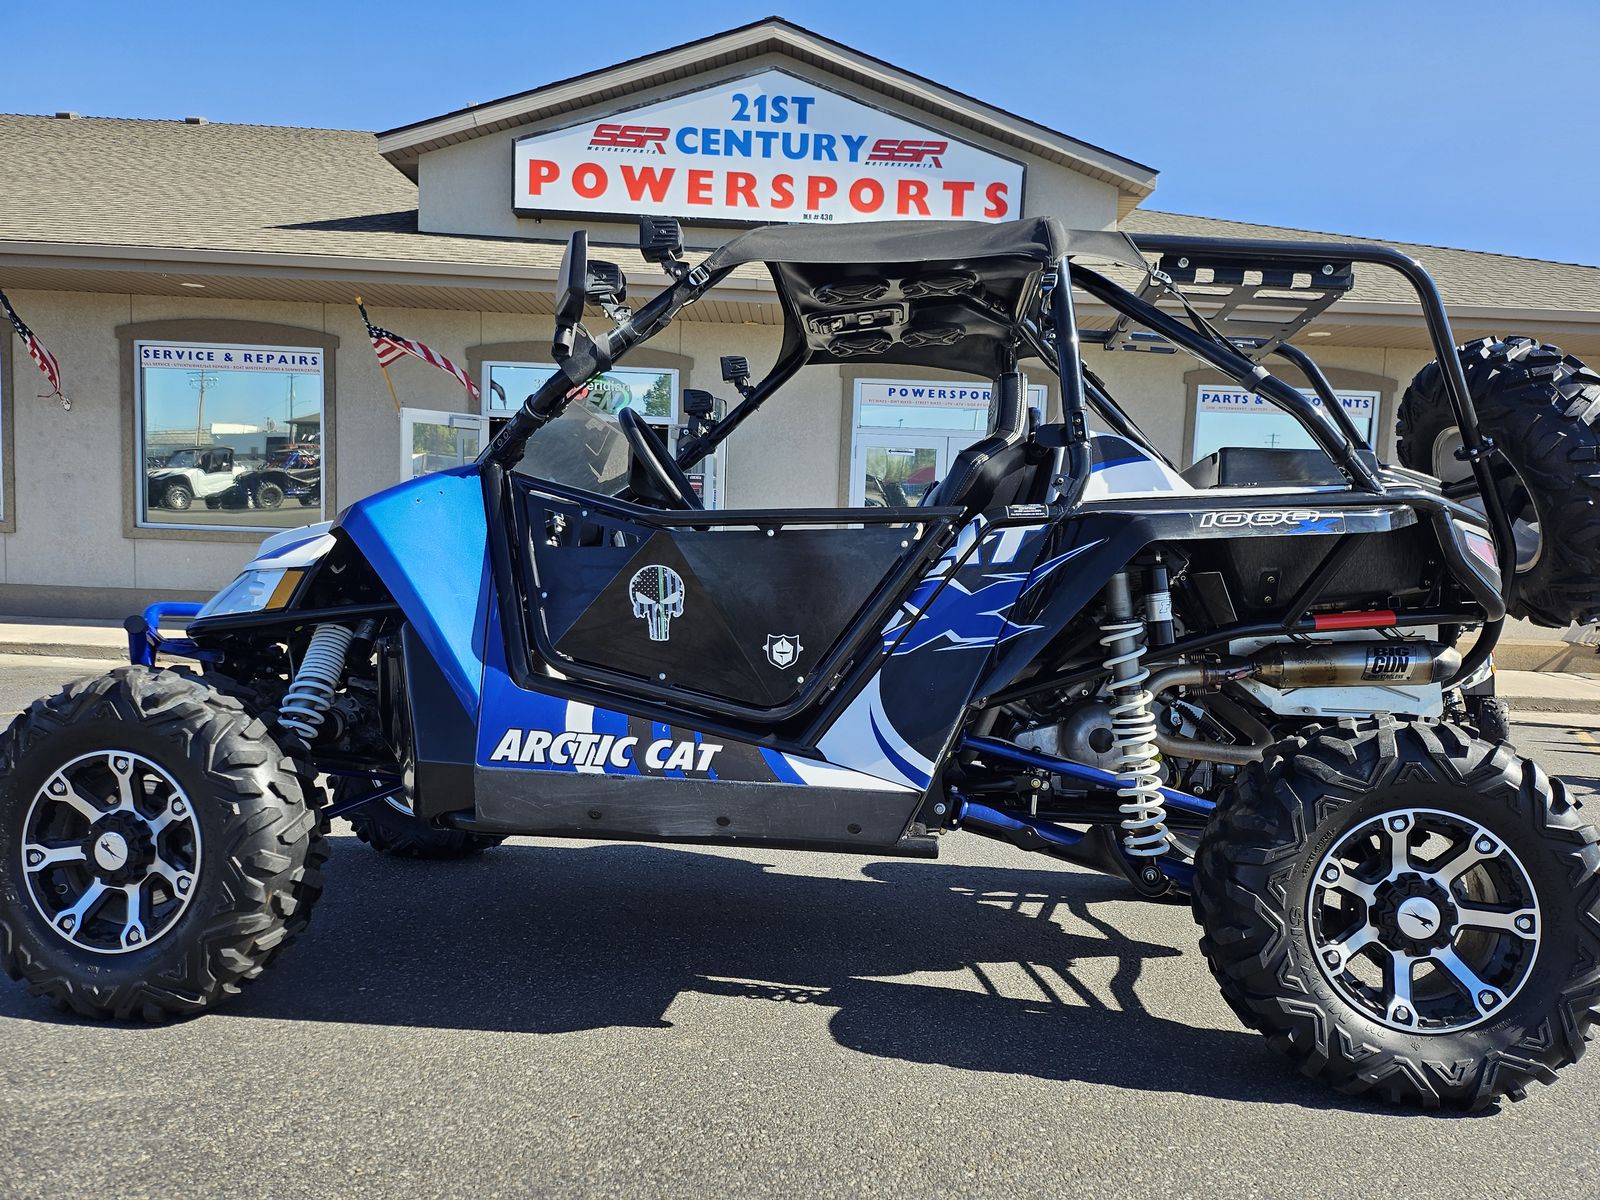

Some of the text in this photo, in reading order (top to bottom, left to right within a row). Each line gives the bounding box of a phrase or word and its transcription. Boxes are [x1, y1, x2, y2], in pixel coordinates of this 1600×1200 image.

[731, 93, 815, 124] 21ST
[589, 124, 671, 154] SSR
[675, 127, 868, 162] CENTURY
[867, 139, 948, 168] SSR
[529, 159, 1008, 218] POWERSPORTS
[143, 349, 318, 366] SERVICE & REPAIRS
[581, 380, 633, 391] eridian
[888, 387, 991, 400] POWERSPOR
[1202, 393, 1263, 405] PARTS &
[1374, 647, 1409, 657] BIG
[1371, 656, 1410, 673] GUN
[490, 728, 724, 771] ARCTIC CAT
